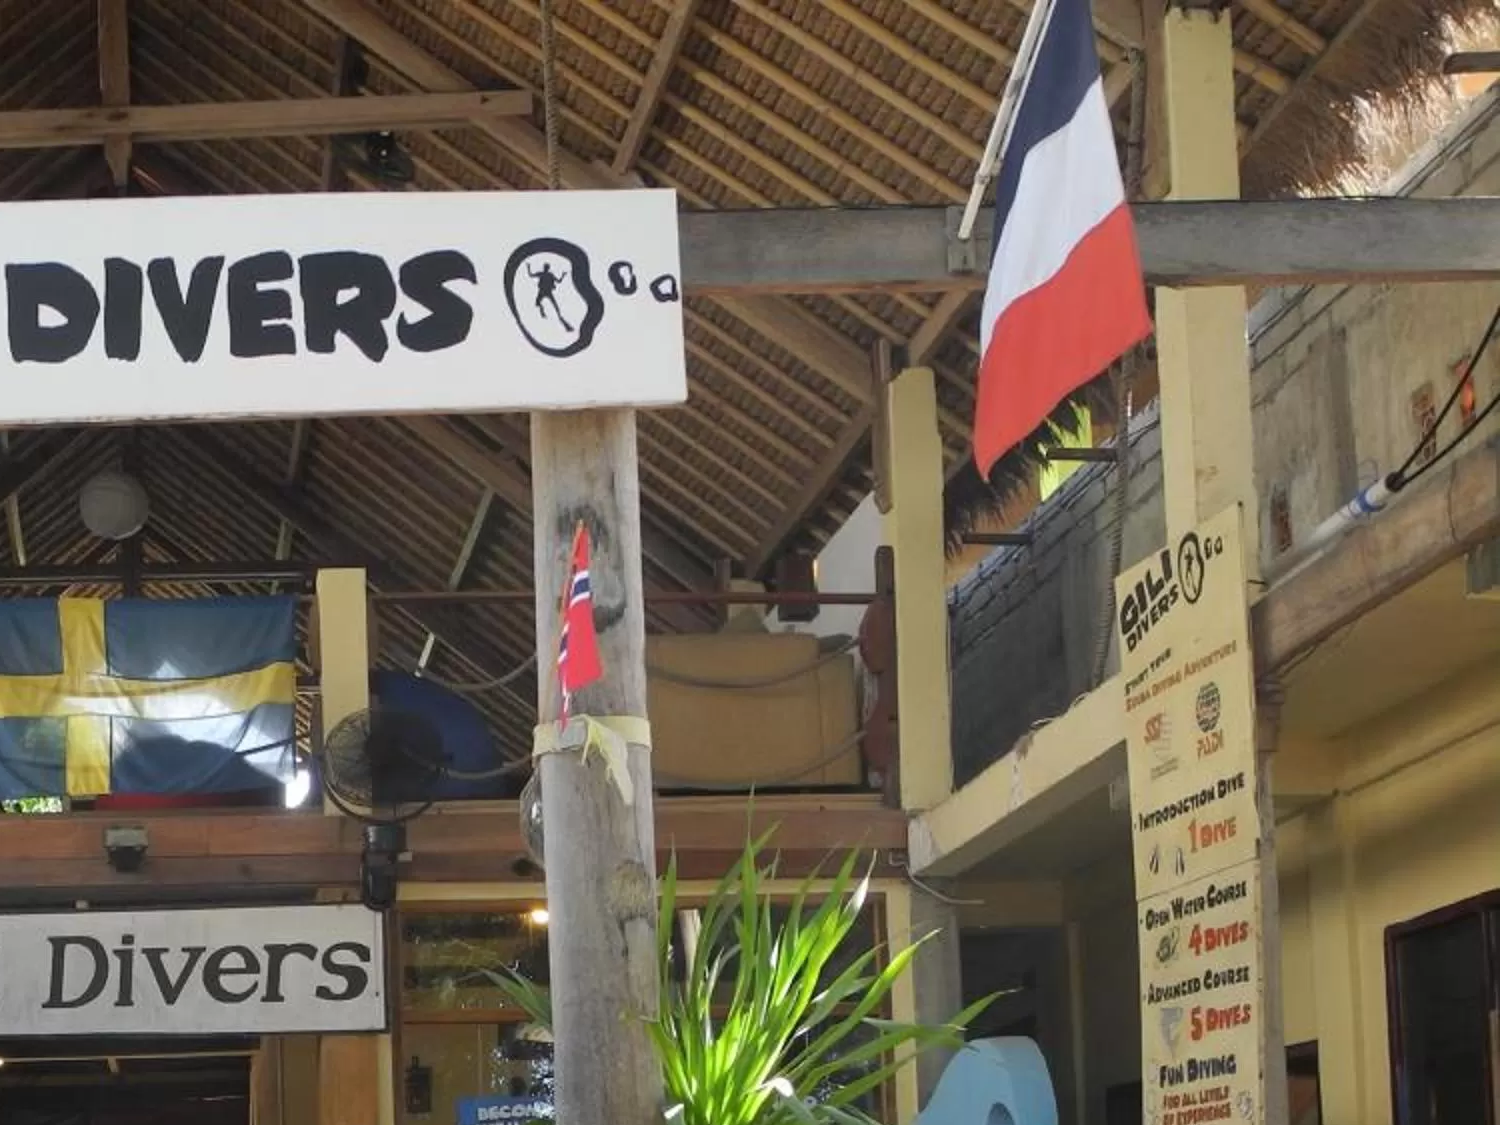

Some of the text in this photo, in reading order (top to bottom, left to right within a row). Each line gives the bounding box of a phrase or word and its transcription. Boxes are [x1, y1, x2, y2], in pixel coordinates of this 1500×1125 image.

[5, 249, 477, 365] DIVERS
[1120, 549, 1173, 636] GILI
[1125, 583, 1179, 652] DIVERS
[1139, 772, 1245, 832] INTRODUCTION DIVE
[1199, 817, 1237, 849] DIVE
[1146, 881, 1246, 931] OPEN WATER COURSE
[1188, 921, 1249, 955] 4 DIVES
[41, 934, 372, 1008] Divers
[1148, 966, 1250, 1005] ADVANCED COURSE
[1190, 1004, 1251, 1040] 5 DIVES
[1159, 1054, 1237, 1088] FUN DIVING
